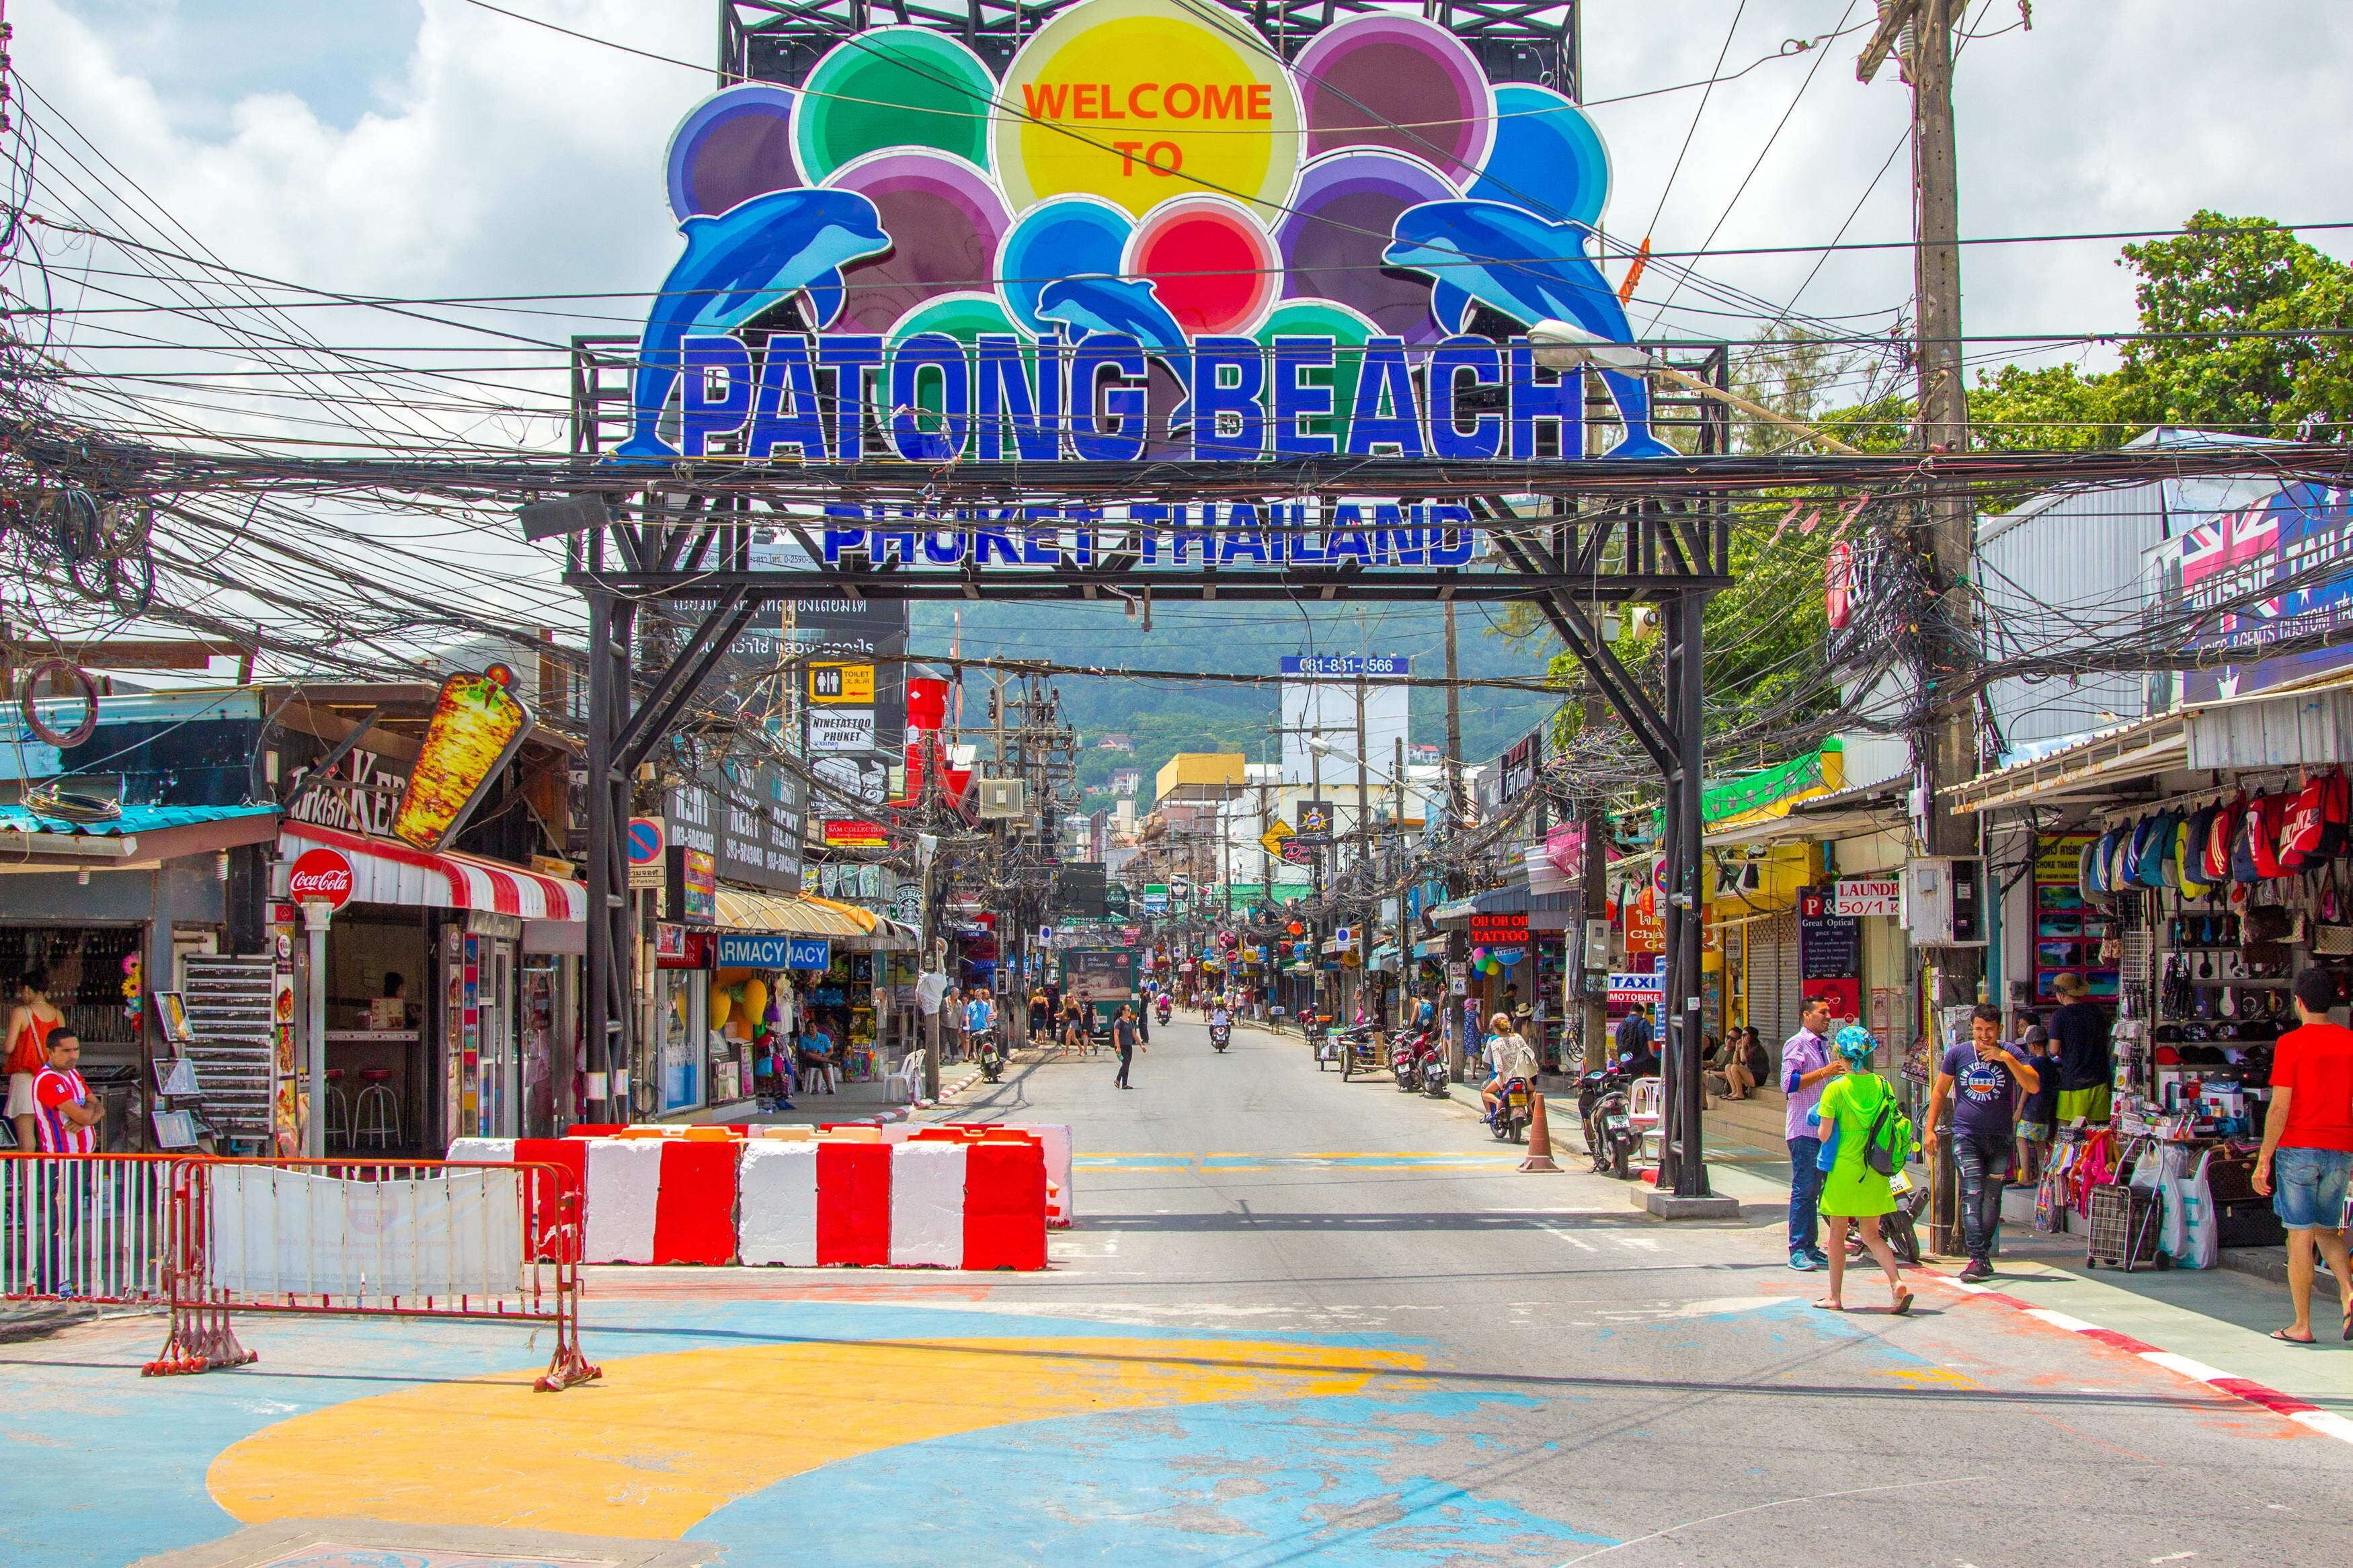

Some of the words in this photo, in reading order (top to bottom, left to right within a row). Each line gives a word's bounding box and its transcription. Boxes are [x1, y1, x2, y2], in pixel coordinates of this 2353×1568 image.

[1022, 83, 1272, 120] WELCOME
[1113, 140, 1183, 177] TO
[680, 332, 1149, 464] PATONG
[1191, 334, 1586, 460] BEACH
[823, 502, 1104, 566] PHUKET
[1129, 503, 1474, 567] THAILAND
[2192, 552, 2276, 610] AUSSIE
[824, 731, 861, 741] PHUKET
[2036, 861, 2055, 869] CHOKE
[2058, 861, 2078, 869] THAVEE
[290, 870, 351, 891] Coca-Cola
[1806, 899, 1818, 915] P
[1802, 919, 1823, 927] Great
[1827, 919, 1854, 929] Optical
[1471, 930, 1530, 942] TATTOO
[1611, 977, 1657, 988] TAXI
[1609, 993, 1660, 1001] MOTOBIKE
[1960, 1069, 1971, 1086] NEW
[1968, 1061, 1991, 1071] YORK
[1991, 1065, 2005, 1087] STATE
